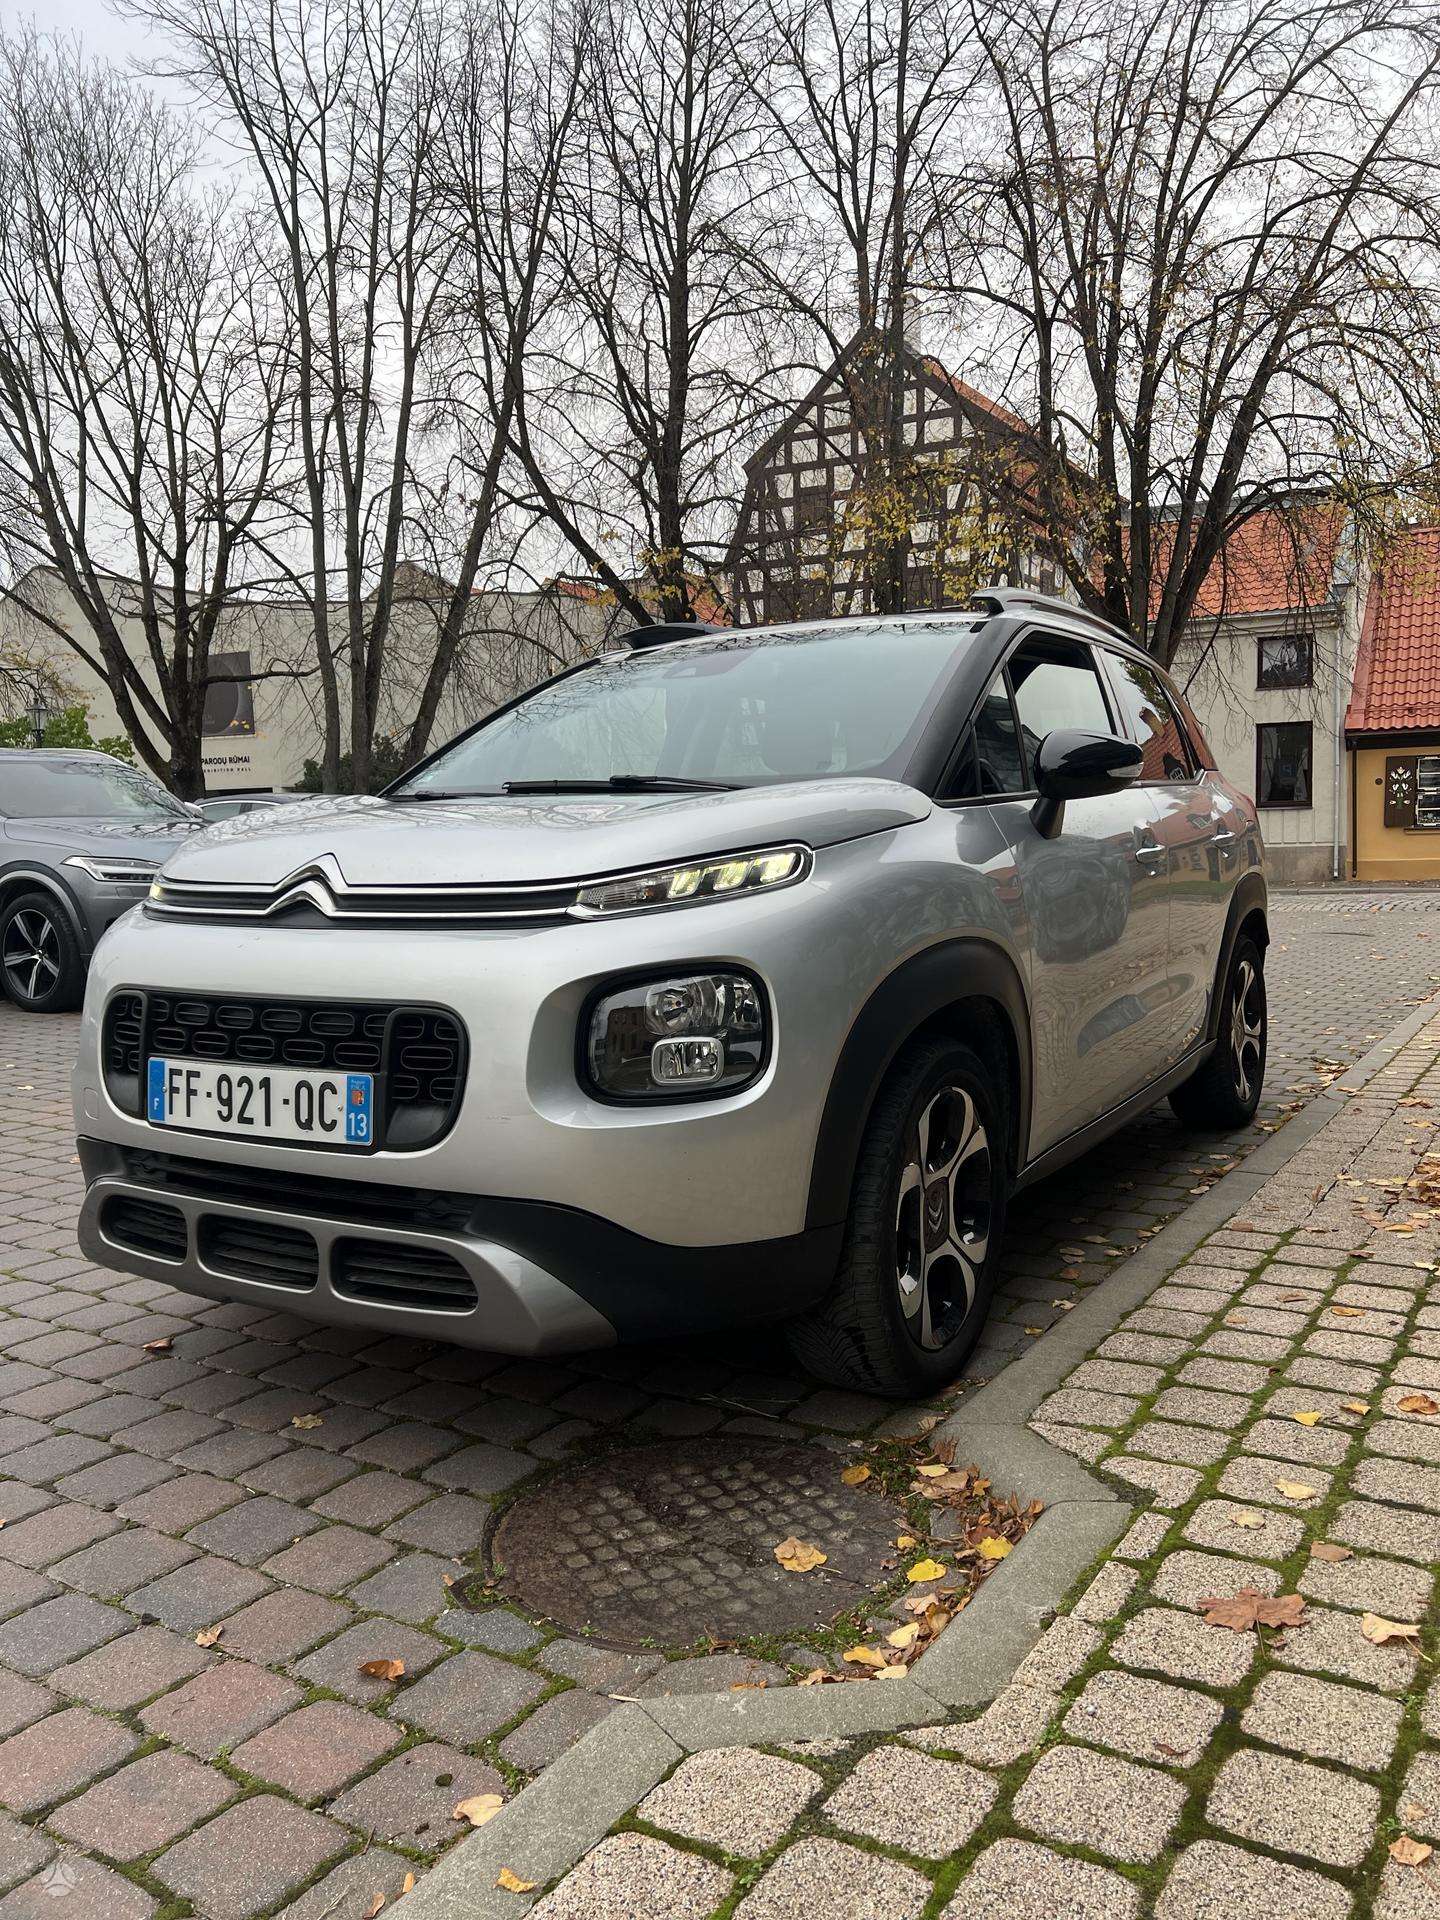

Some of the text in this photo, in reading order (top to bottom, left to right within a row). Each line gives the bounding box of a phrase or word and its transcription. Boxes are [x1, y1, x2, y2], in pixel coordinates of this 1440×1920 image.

[154, 1097, 160, 1111] F
[168, 1068, 338, 1132] FF-921-QC
[348, 1112, 368, 1137] 13
